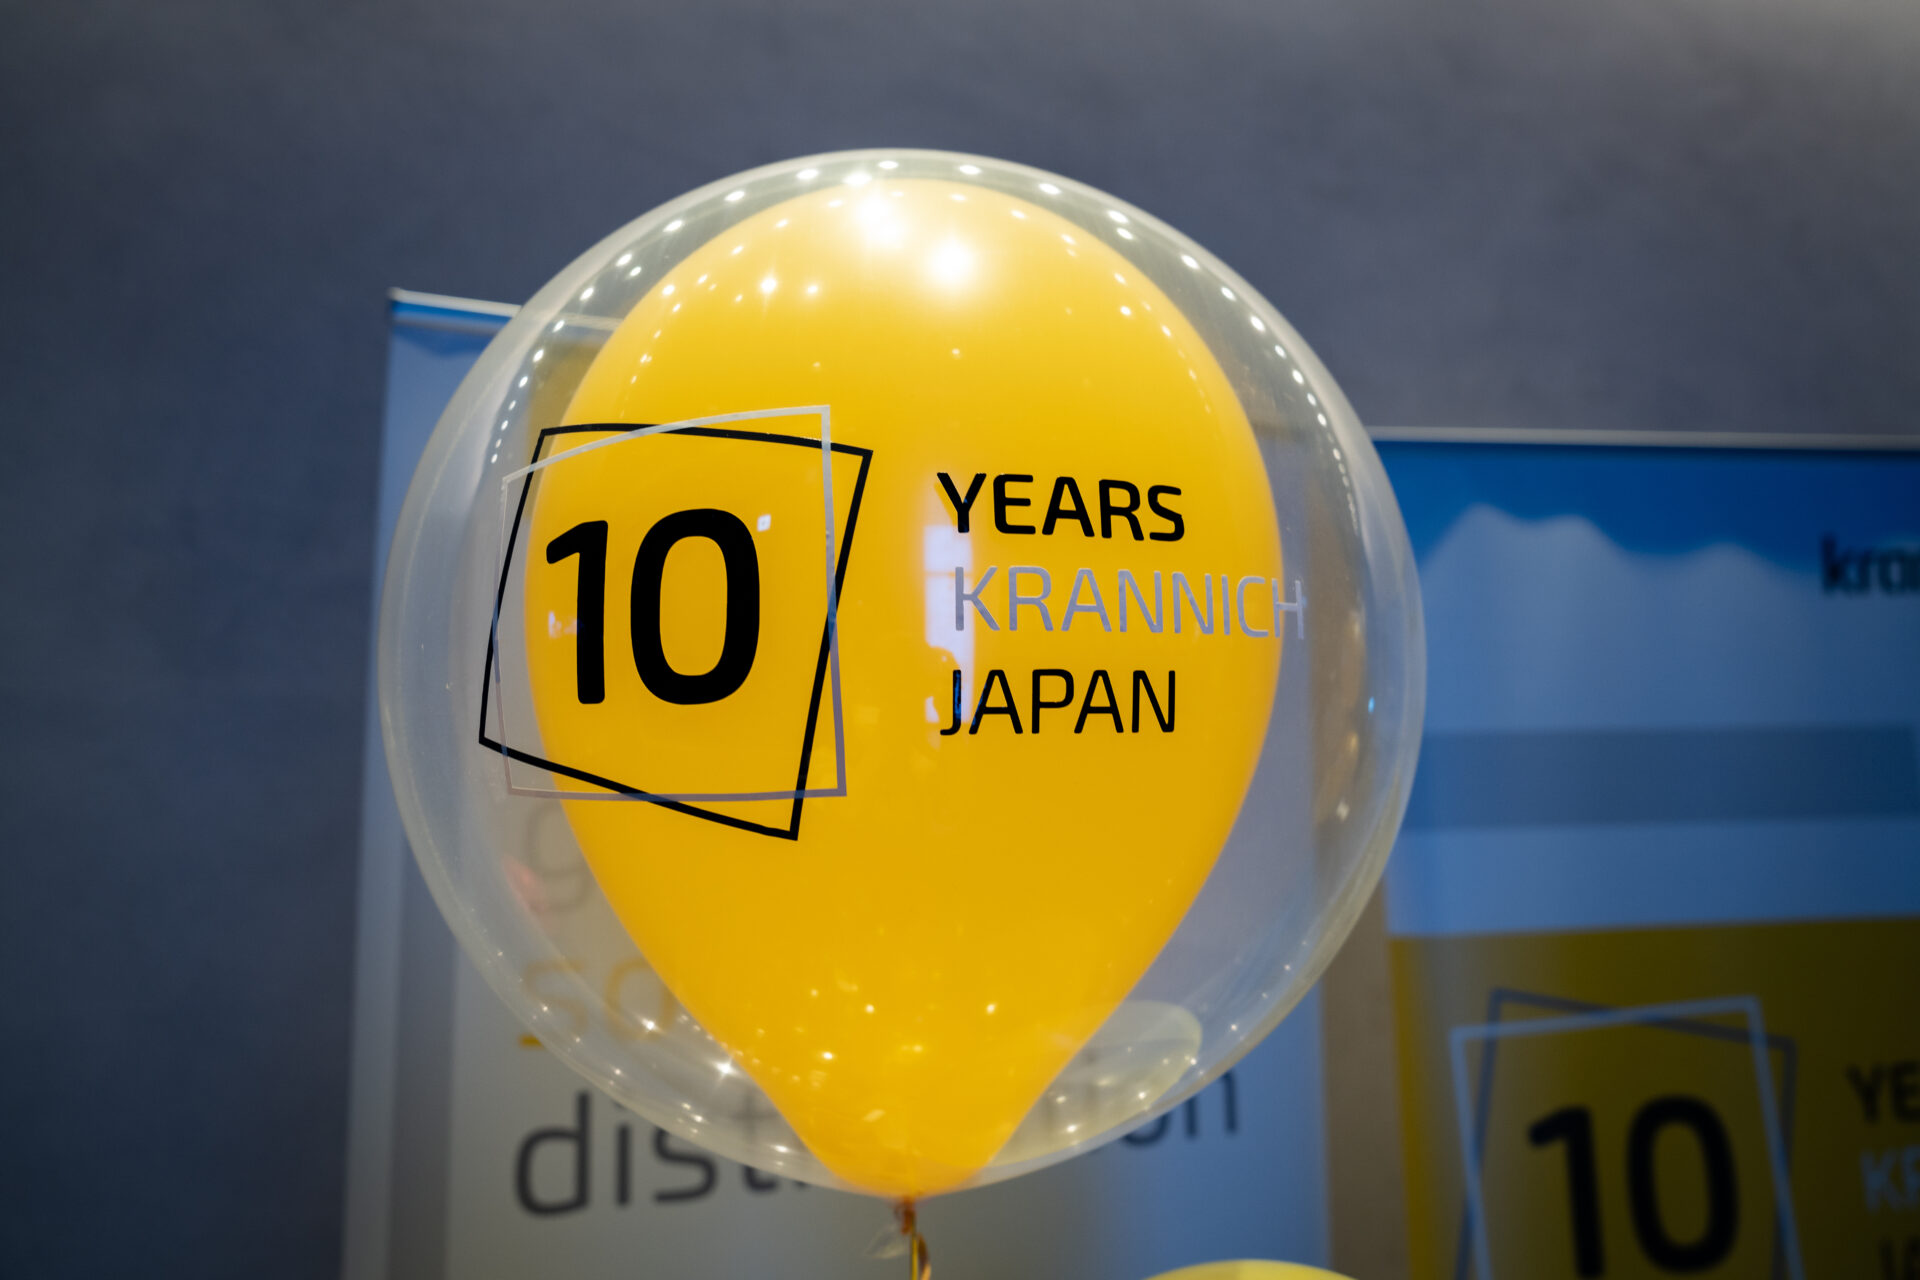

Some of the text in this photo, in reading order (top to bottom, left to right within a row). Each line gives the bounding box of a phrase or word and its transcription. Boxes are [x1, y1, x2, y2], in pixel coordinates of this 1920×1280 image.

[937, 472, 1186, 542] YEARS
[546, 508, 761, 705] 10
[954, 566, 1305, 640] KRANNICH
[939, 669, 1177, 736] JAPAN
[1526, 1092, 1741, 1280] 10
